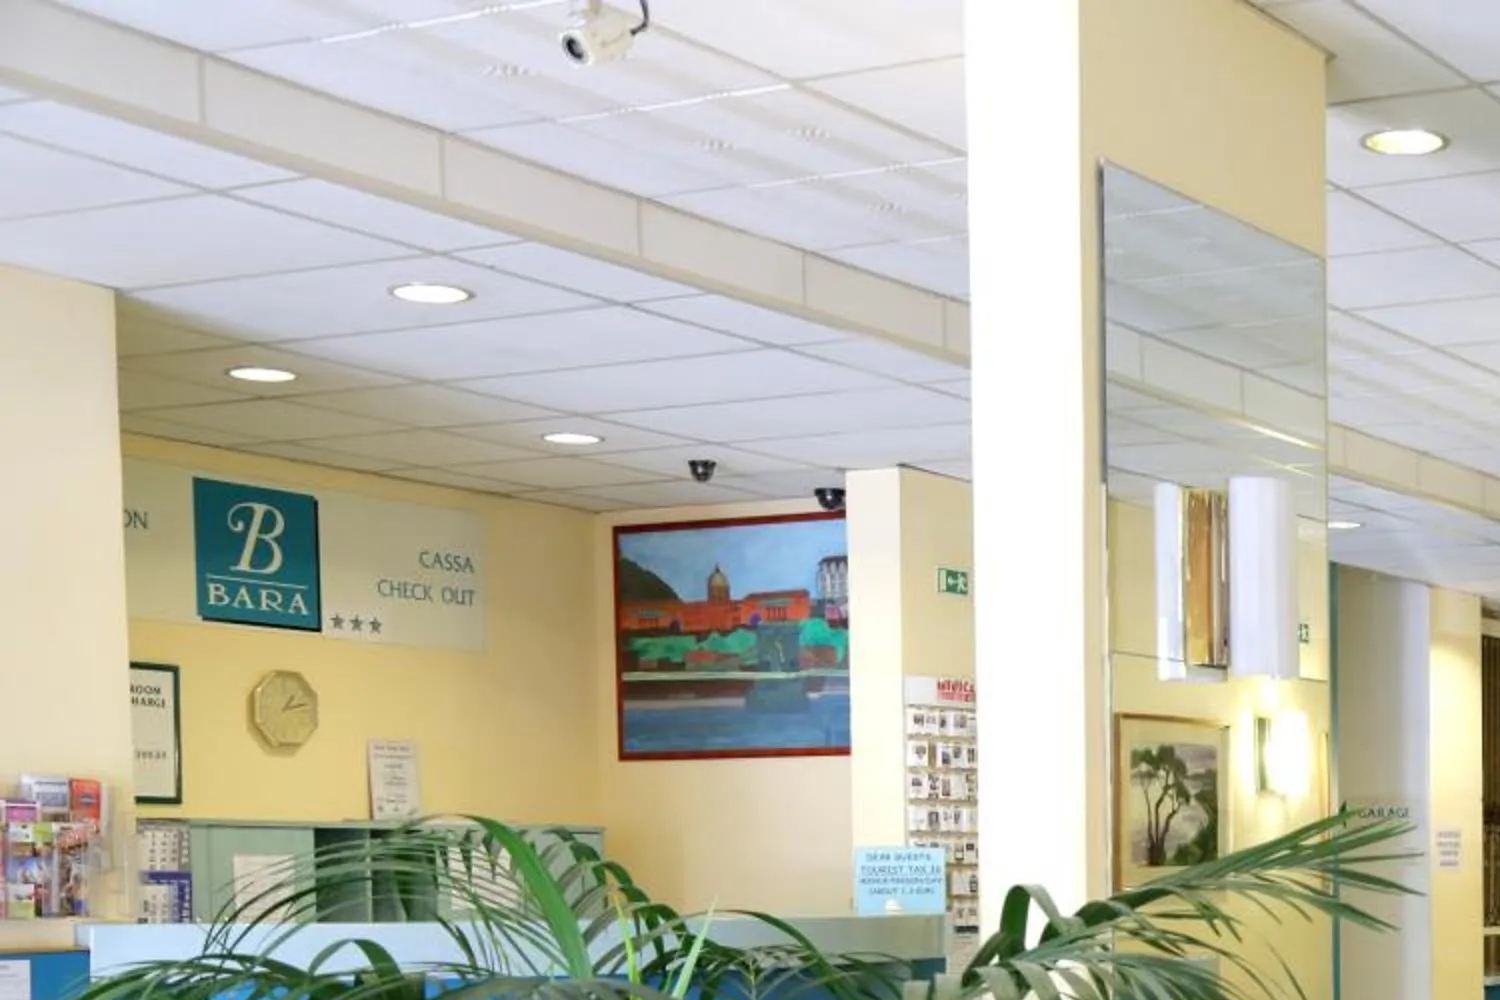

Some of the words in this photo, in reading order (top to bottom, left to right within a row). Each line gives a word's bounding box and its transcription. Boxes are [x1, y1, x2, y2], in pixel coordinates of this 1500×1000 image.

[227, 502, 285, 575] B
[418, 550, 475, 574] CASSA
[207, 582, 311, 616] BARA
[376, 579, 433, 602] CHECK
[440, 587, 476, 607] OUT
[1358, 807, 1409, 819] GARAGE
